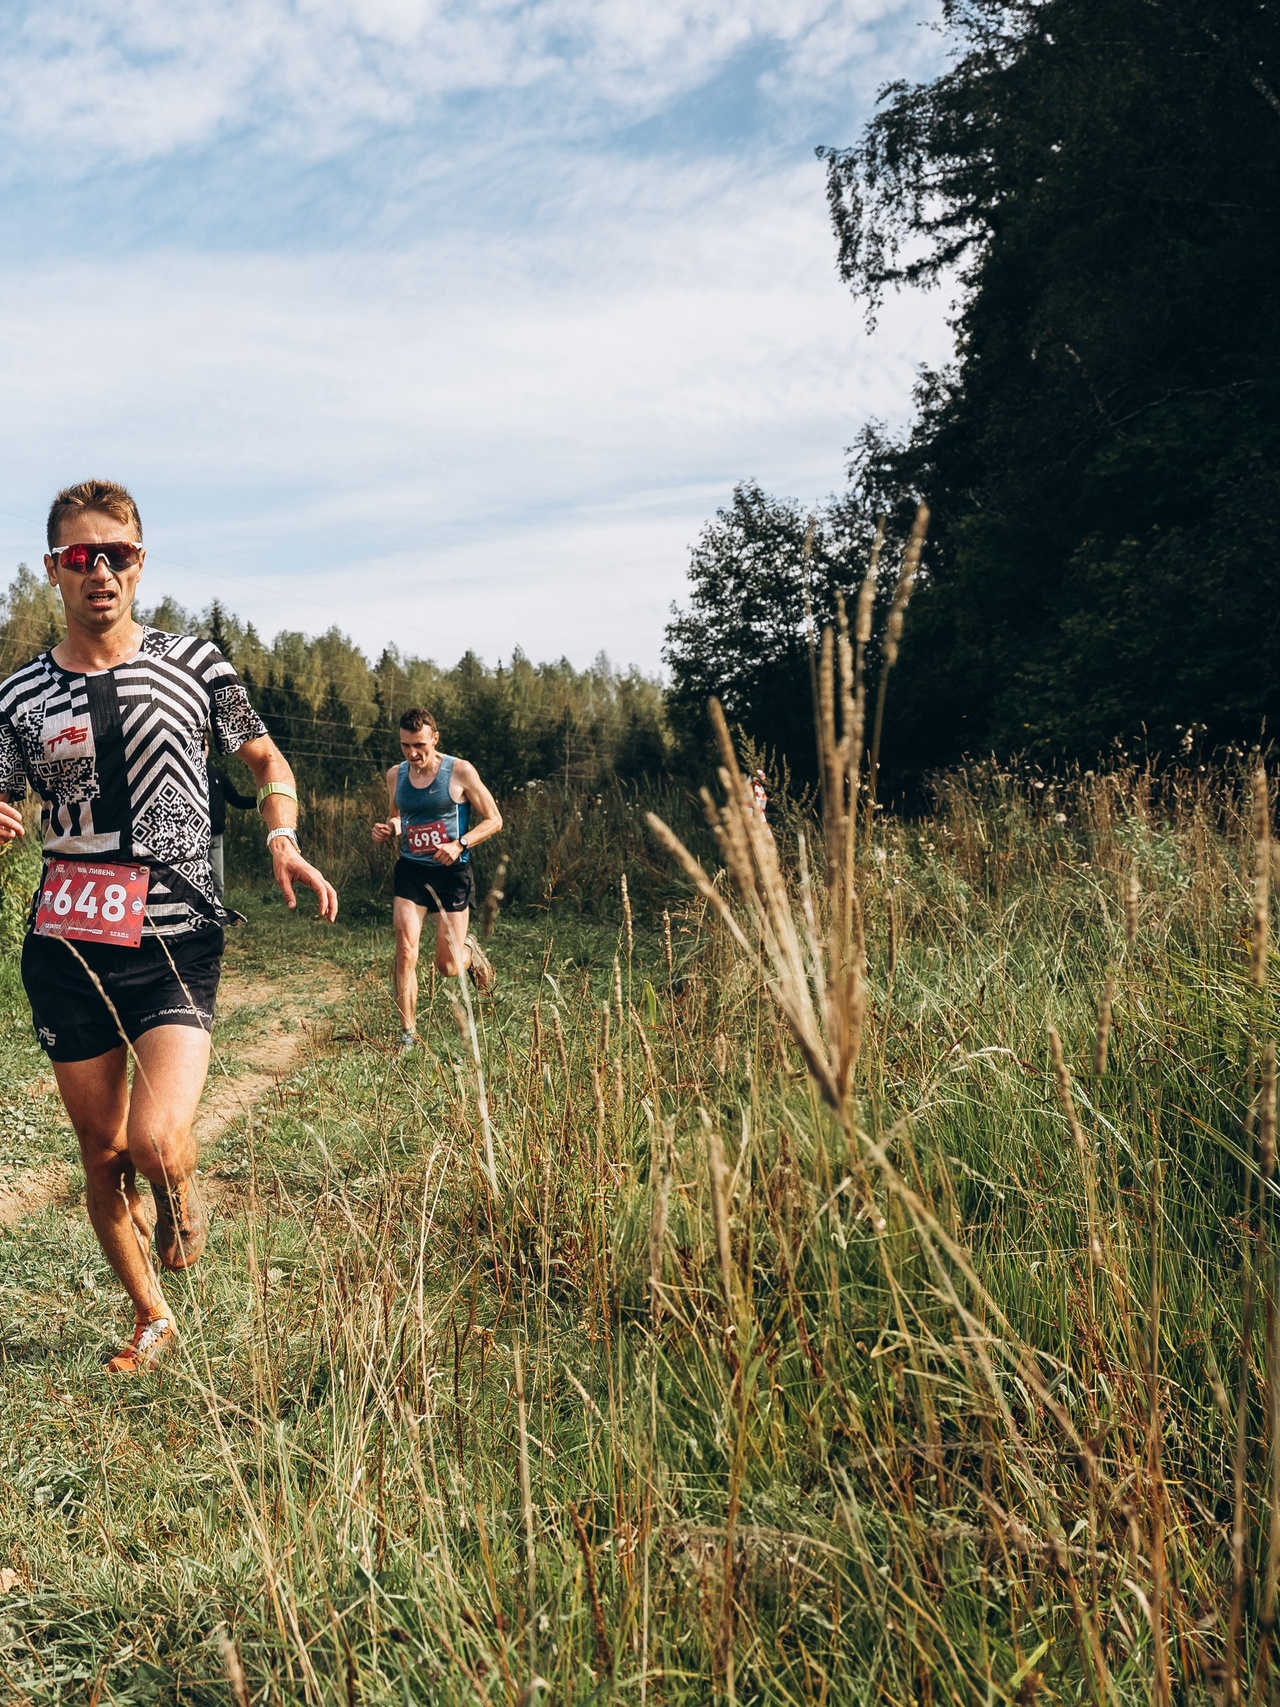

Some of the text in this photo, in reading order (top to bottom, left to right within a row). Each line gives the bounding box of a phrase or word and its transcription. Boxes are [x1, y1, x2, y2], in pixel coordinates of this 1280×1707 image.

[414, 830, 441, 847] 698
[88, 867, 115, 877] ЛИВЕНЬ
[129, 871, 137, 881] S
[53, 879, 127, 922] 648
[140, 1013, 157, 1024] TRAIL
[158, 1007, 195, 1016] RUNNING
